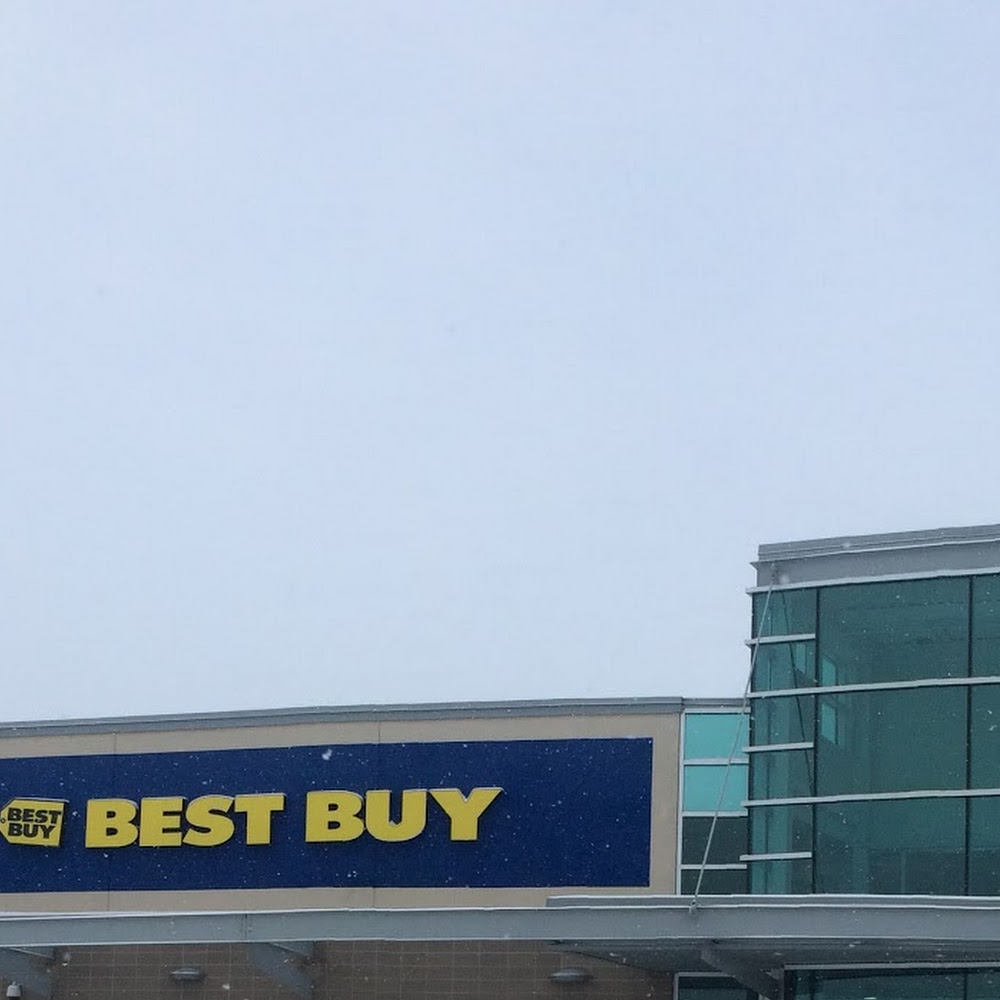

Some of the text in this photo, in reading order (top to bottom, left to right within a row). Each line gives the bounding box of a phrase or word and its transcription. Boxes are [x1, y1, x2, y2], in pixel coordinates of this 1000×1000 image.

[8, 807, 61, 824] BEST
[85, 787, 502, 848] BEST BUY
[8, 823, 56, 839] BUY
